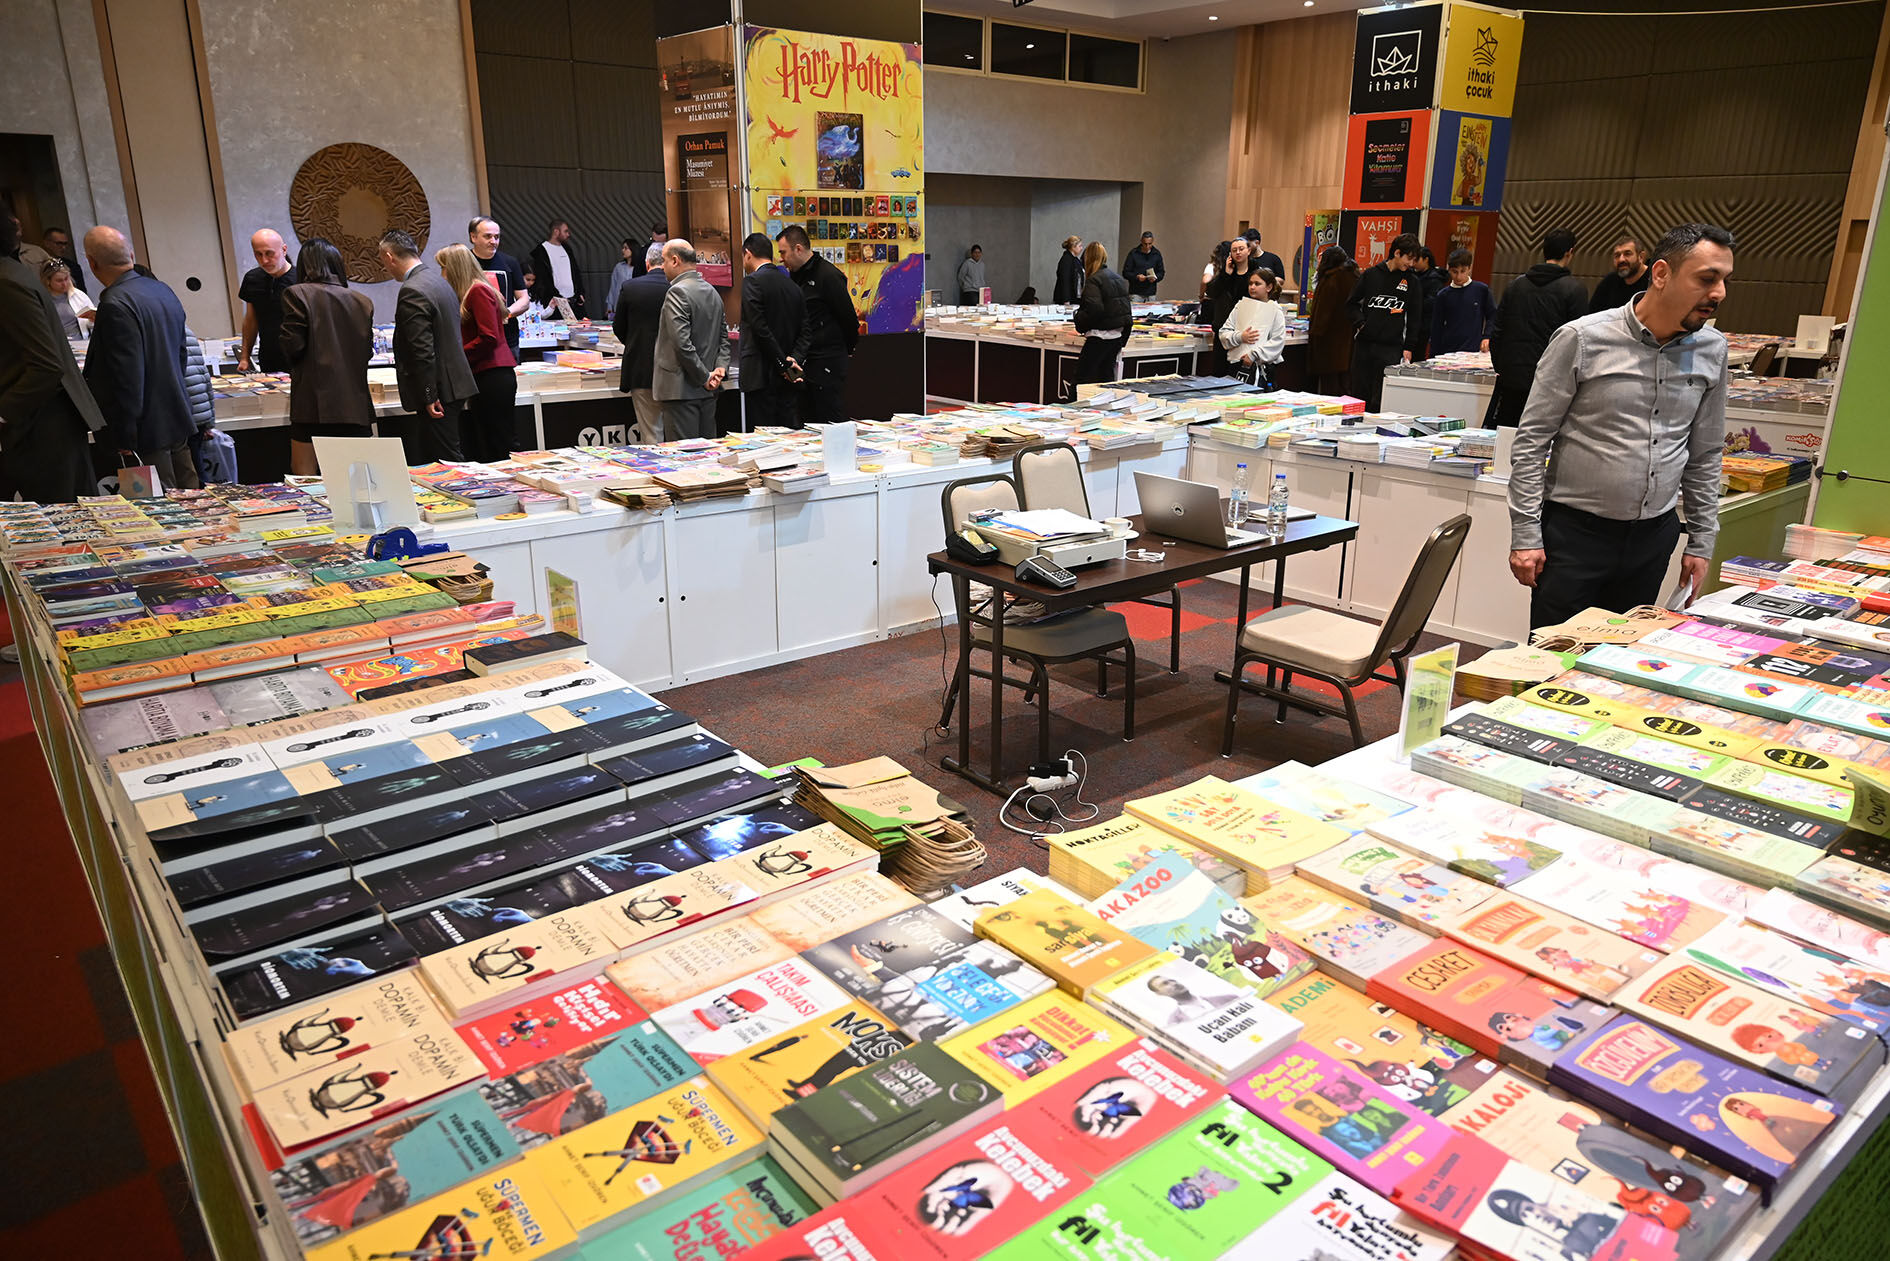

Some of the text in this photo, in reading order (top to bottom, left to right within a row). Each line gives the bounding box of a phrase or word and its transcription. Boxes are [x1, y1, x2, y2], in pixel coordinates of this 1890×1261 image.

[776, 41, 902, 112] Harry Potter
[1367, 76, 1418, 93] ithaki
[1466, 84, 1492, 99] çocuk
[1467, 67, 1496, 85] ithaki
[674, 106, 682, 114] EN
[683, 104, 702, 113] MUTLU
[685, 139, 725, 151] Orhan Pamuk
[686, 158, 714, 170] Masumiyet
[1361, 217, 1398, 234] VAHŞİ
[1368, 294, 1405, 310] KTM
[1577, 624, 1637, 636] elma
[551, 916, 595, 957] DOPAMİN
[777, 962, 813, 988] TAKIM
[1406, 950, 1476, 992] CESARET
[379, 982, 421, 1028] DOPAMİN
[753, 970, 819, 1018] ÇALIŞMASI
[1197, 1000, 1255, 1035] Uçan Halı
[1212, 1016, 1258, 1044] Babam
[414, 1034, 461, 1080] DOPAMİN
[630, 1037, 649, 1056] TÜRK
[651, 1043, 687, 1077] SÜPERMEN
[888, 1057, 943, 1099] SİSTEM
[1115, 1053, 1197, 1109] Kelebek
[681, 1089, 740, 1147] SÜPERMEN
[974, 1131, 1056, 1202] Kelebek
[1262, 1171, 1293, 1195] 2
[494, 1177, 546, 1248] SÜPERMEN
